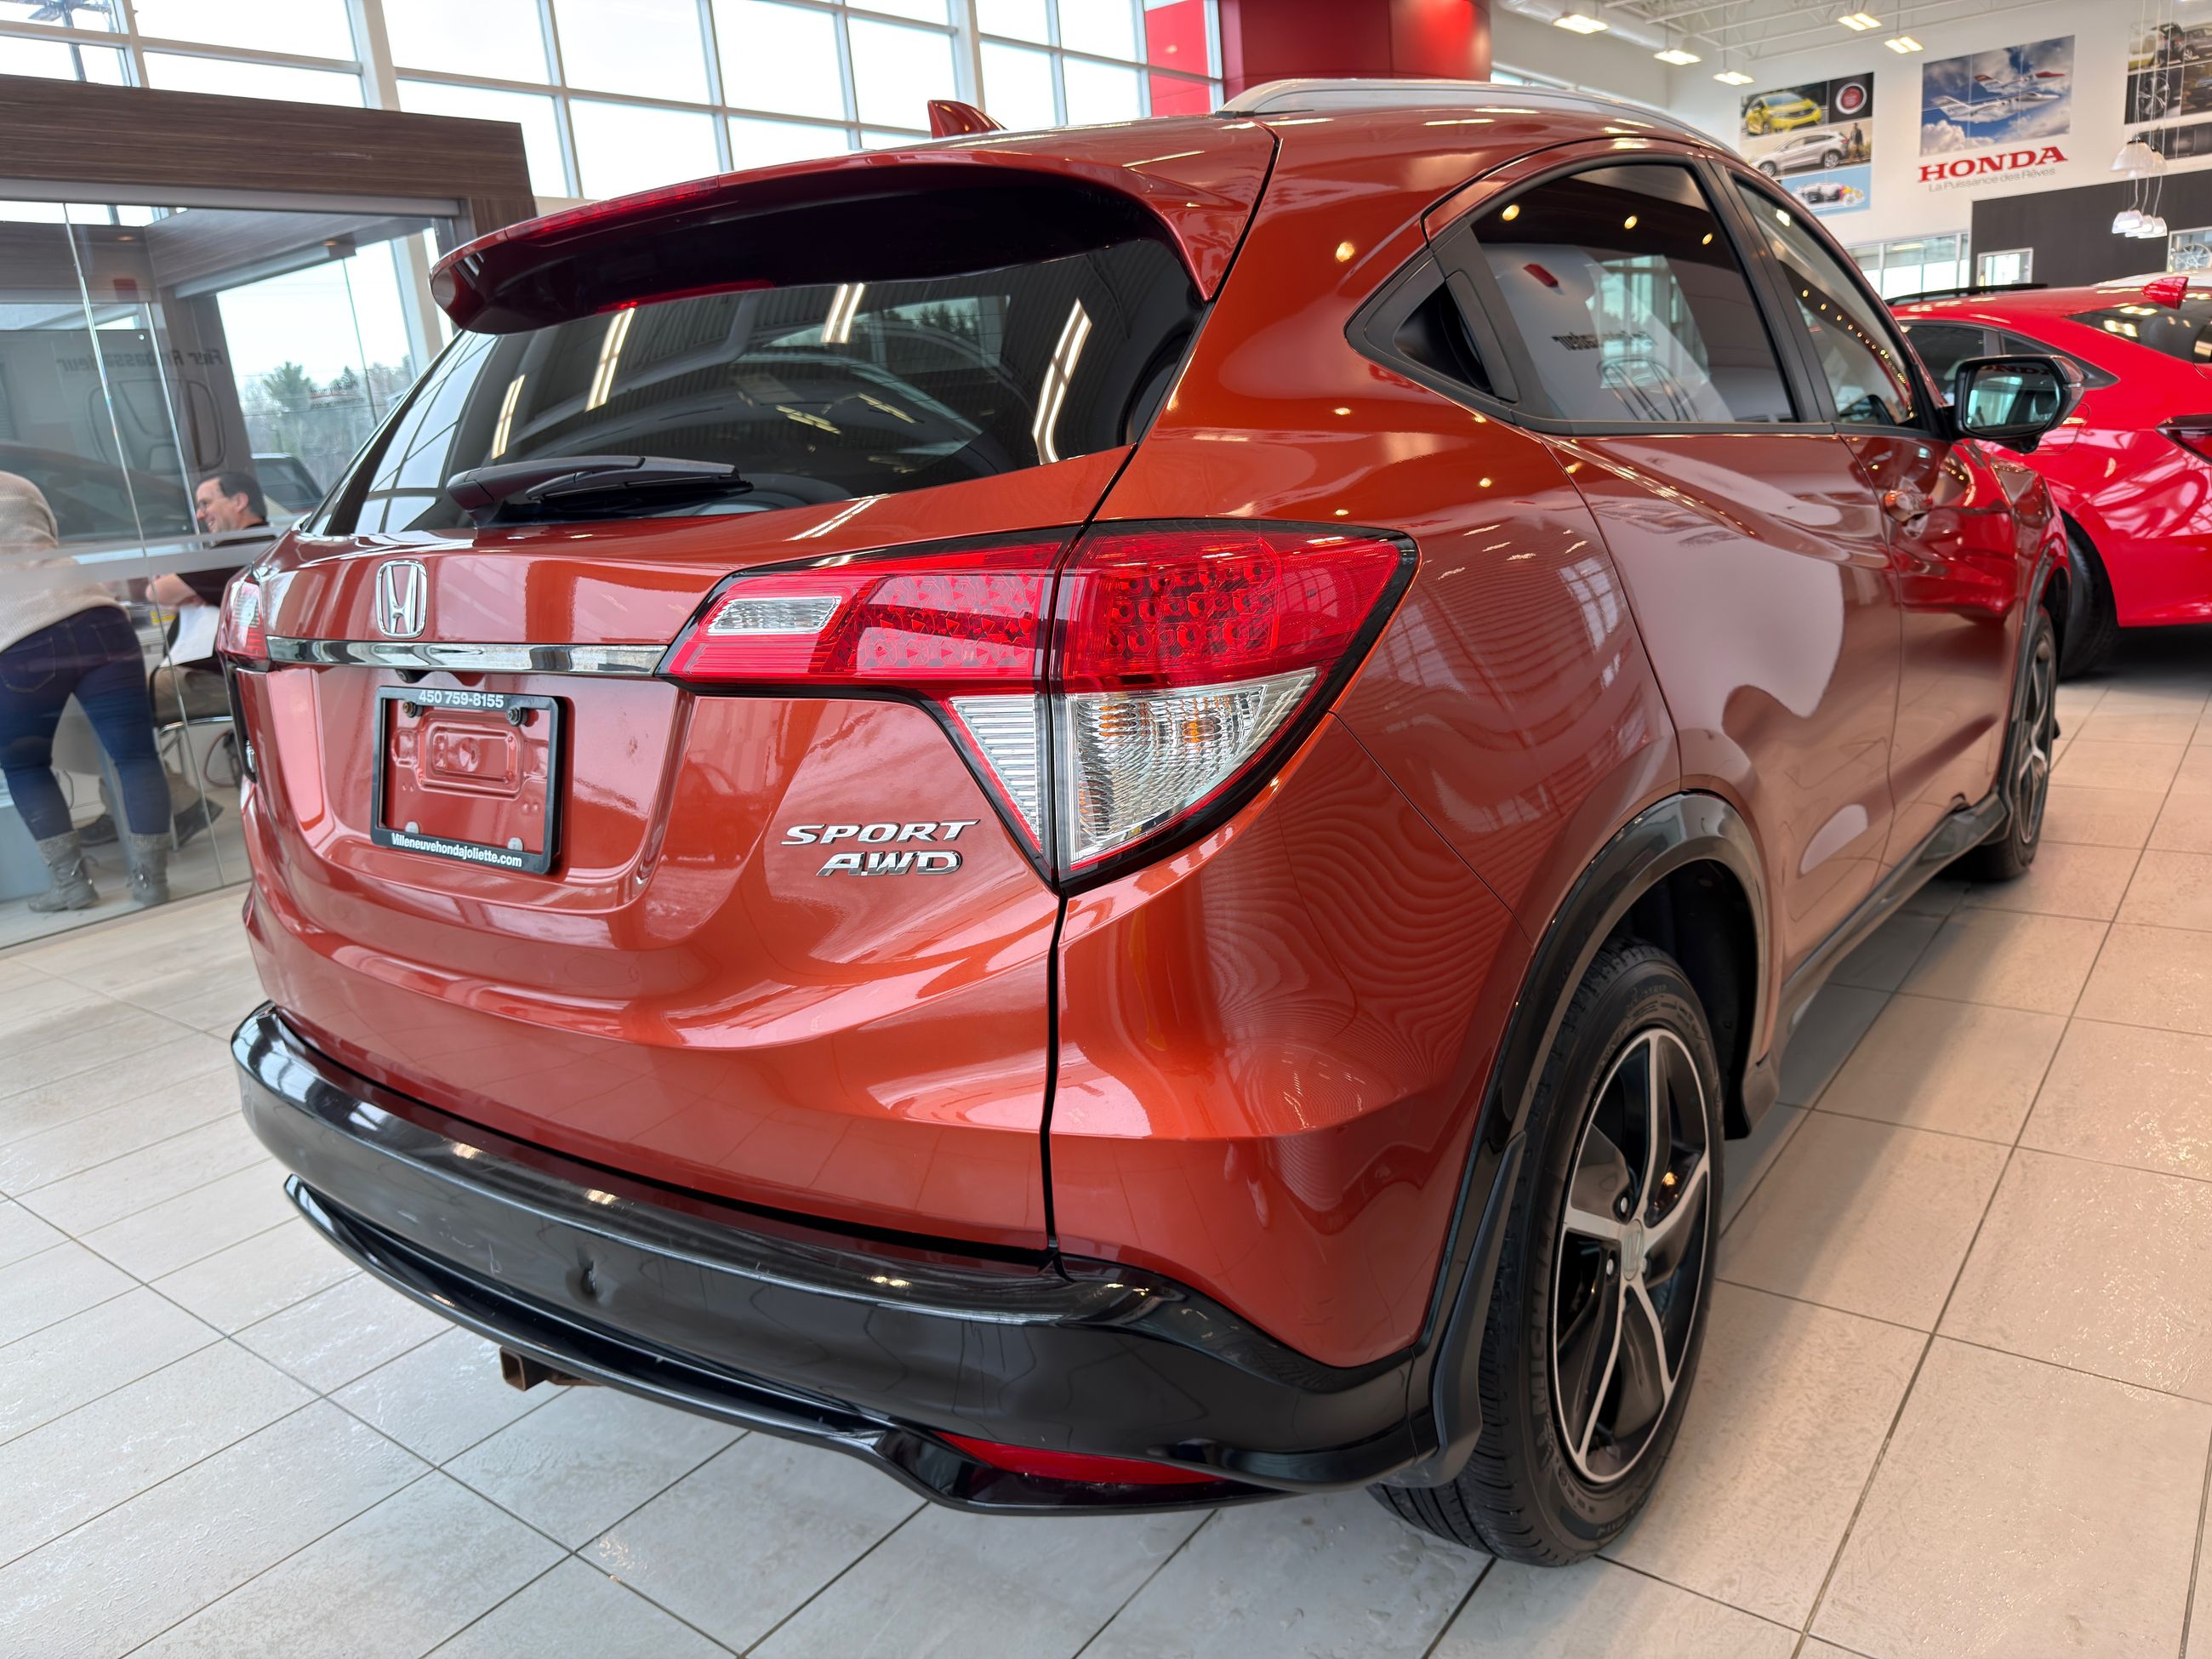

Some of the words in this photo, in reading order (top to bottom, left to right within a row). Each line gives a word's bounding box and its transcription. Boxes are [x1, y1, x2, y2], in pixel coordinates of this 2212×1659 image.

[1918, 146, 2068, 183] HONDA
[1929, 181, 1942, 191] La
[1944, 176, 1998, 190] Puissance
[2000, 172, 2021, 182] des
[419, 690, 442, 704] 450
[444, 691, 505, 709] 759-8155
[780, 819, 981, 846] SPORT
[391, 832, 522, 868] Villeneuvehondajoliette.com
[816, 850, 963, 876] AWD
